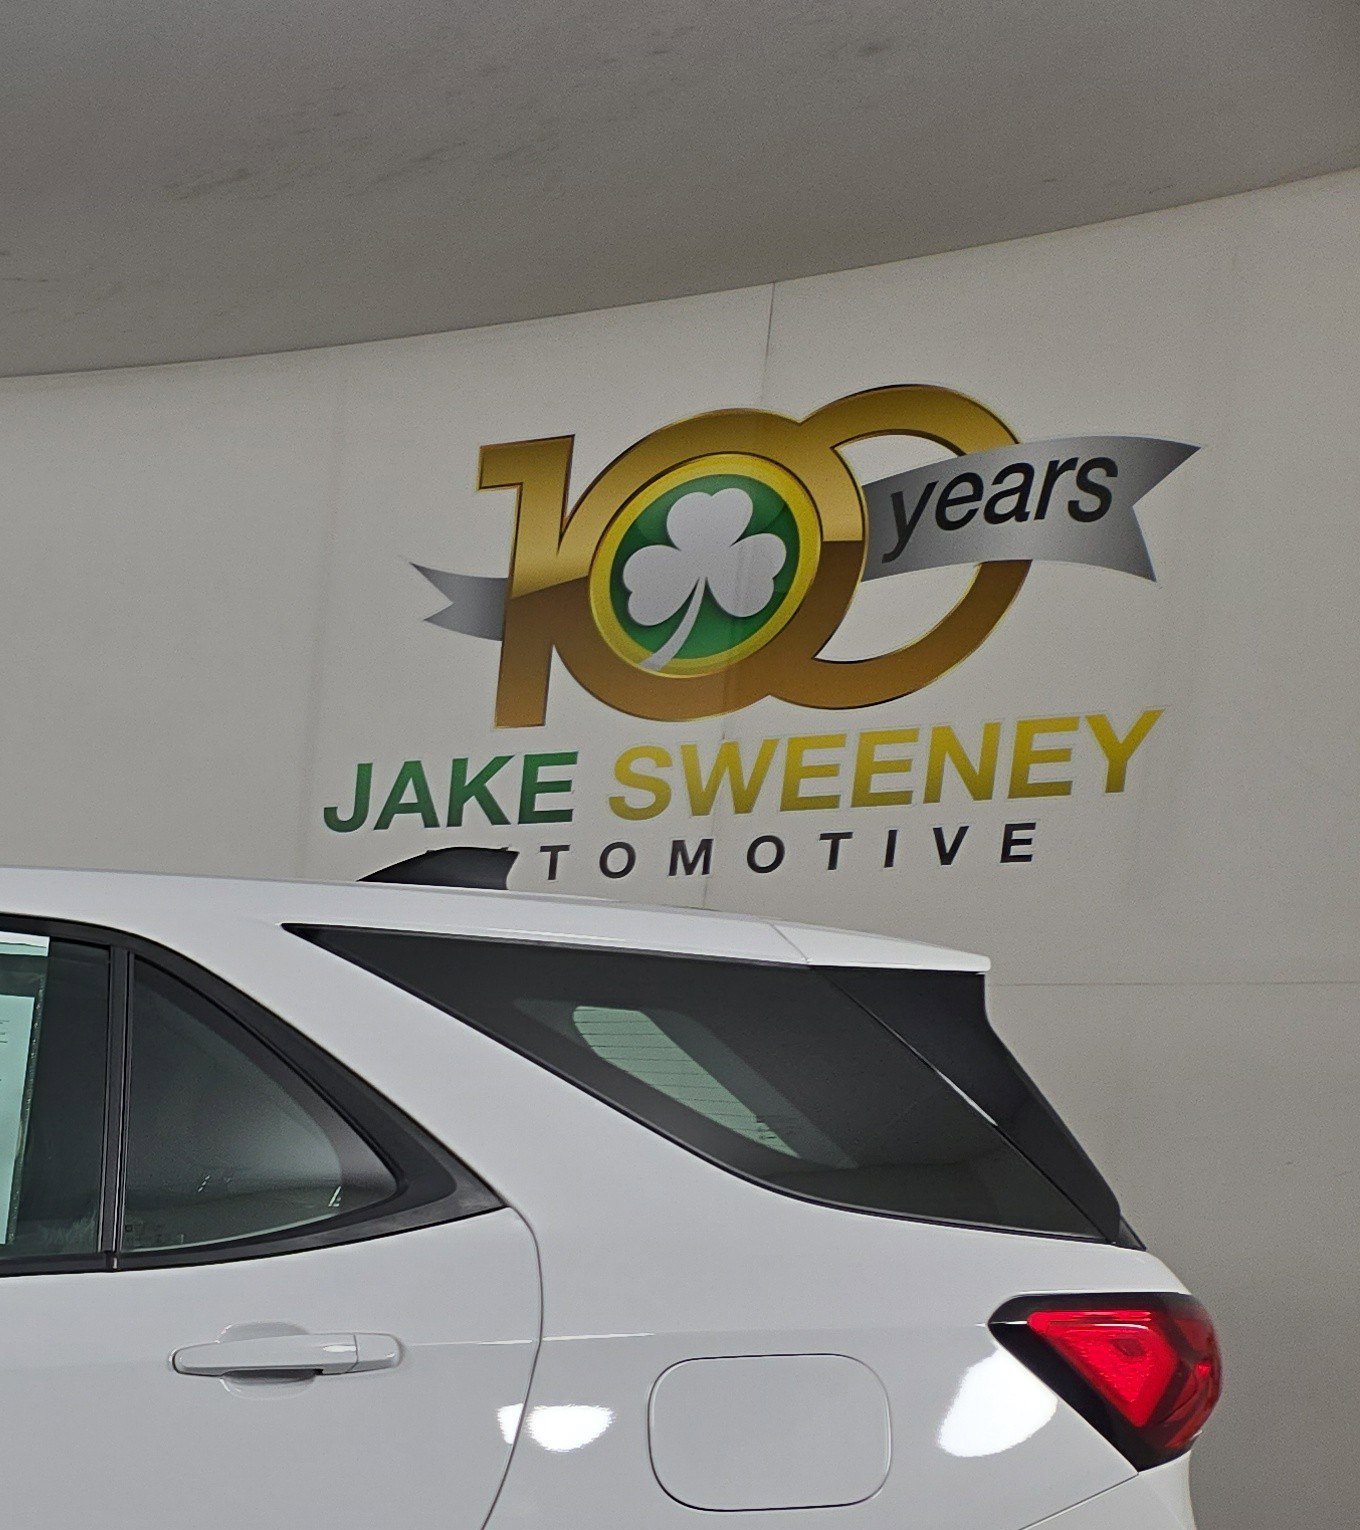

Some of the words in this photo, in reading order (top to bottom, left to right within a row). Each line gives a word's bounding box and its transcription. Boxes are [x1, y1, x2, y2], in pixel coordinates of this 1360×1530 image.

[881, 456, 1119, 562] years
[323, 751, 579, 833] JAKE
[609, 709, 1165, 821] SWEENEY
[480, 821, 1039, 882] TOMOTIVE
